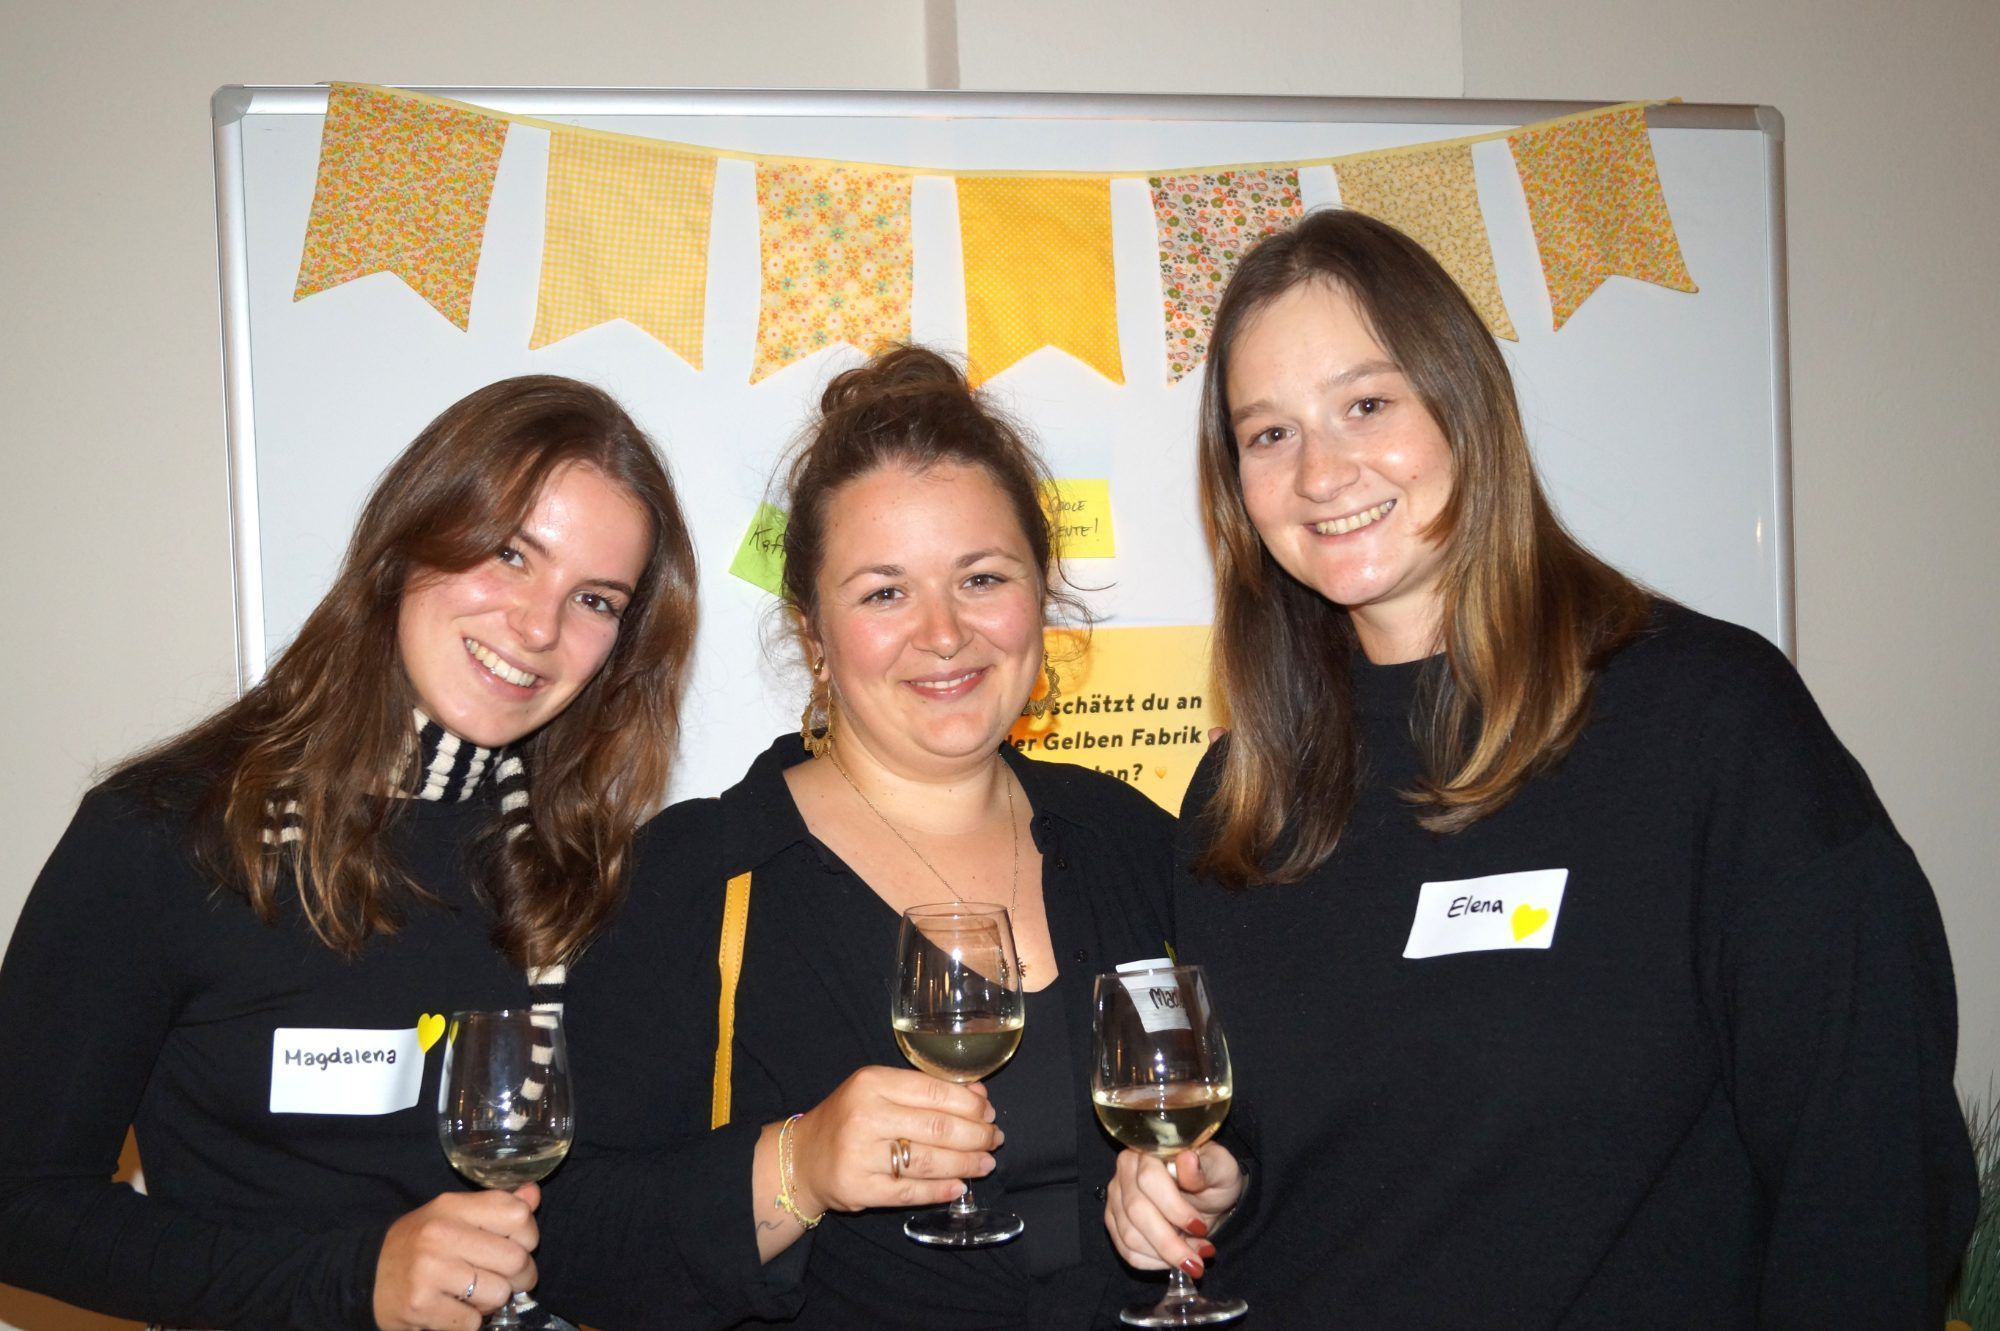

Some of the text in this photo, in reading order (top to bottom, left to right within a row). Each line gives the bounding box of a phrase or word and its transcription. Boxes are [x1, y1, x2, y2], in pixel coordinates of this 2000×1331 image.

[1052, 693, 1135, 715] schätzt
[1141, 692, 1169, 712] du
[1176, 695, 1202, 710] an
[1043, 732, 1123, 751] Gelben
[1131, 726, 1203, 747] Fabrik
[1447, 895, 1503, 918] Elena
[285, 1047, 397, 1071] Magdalena
